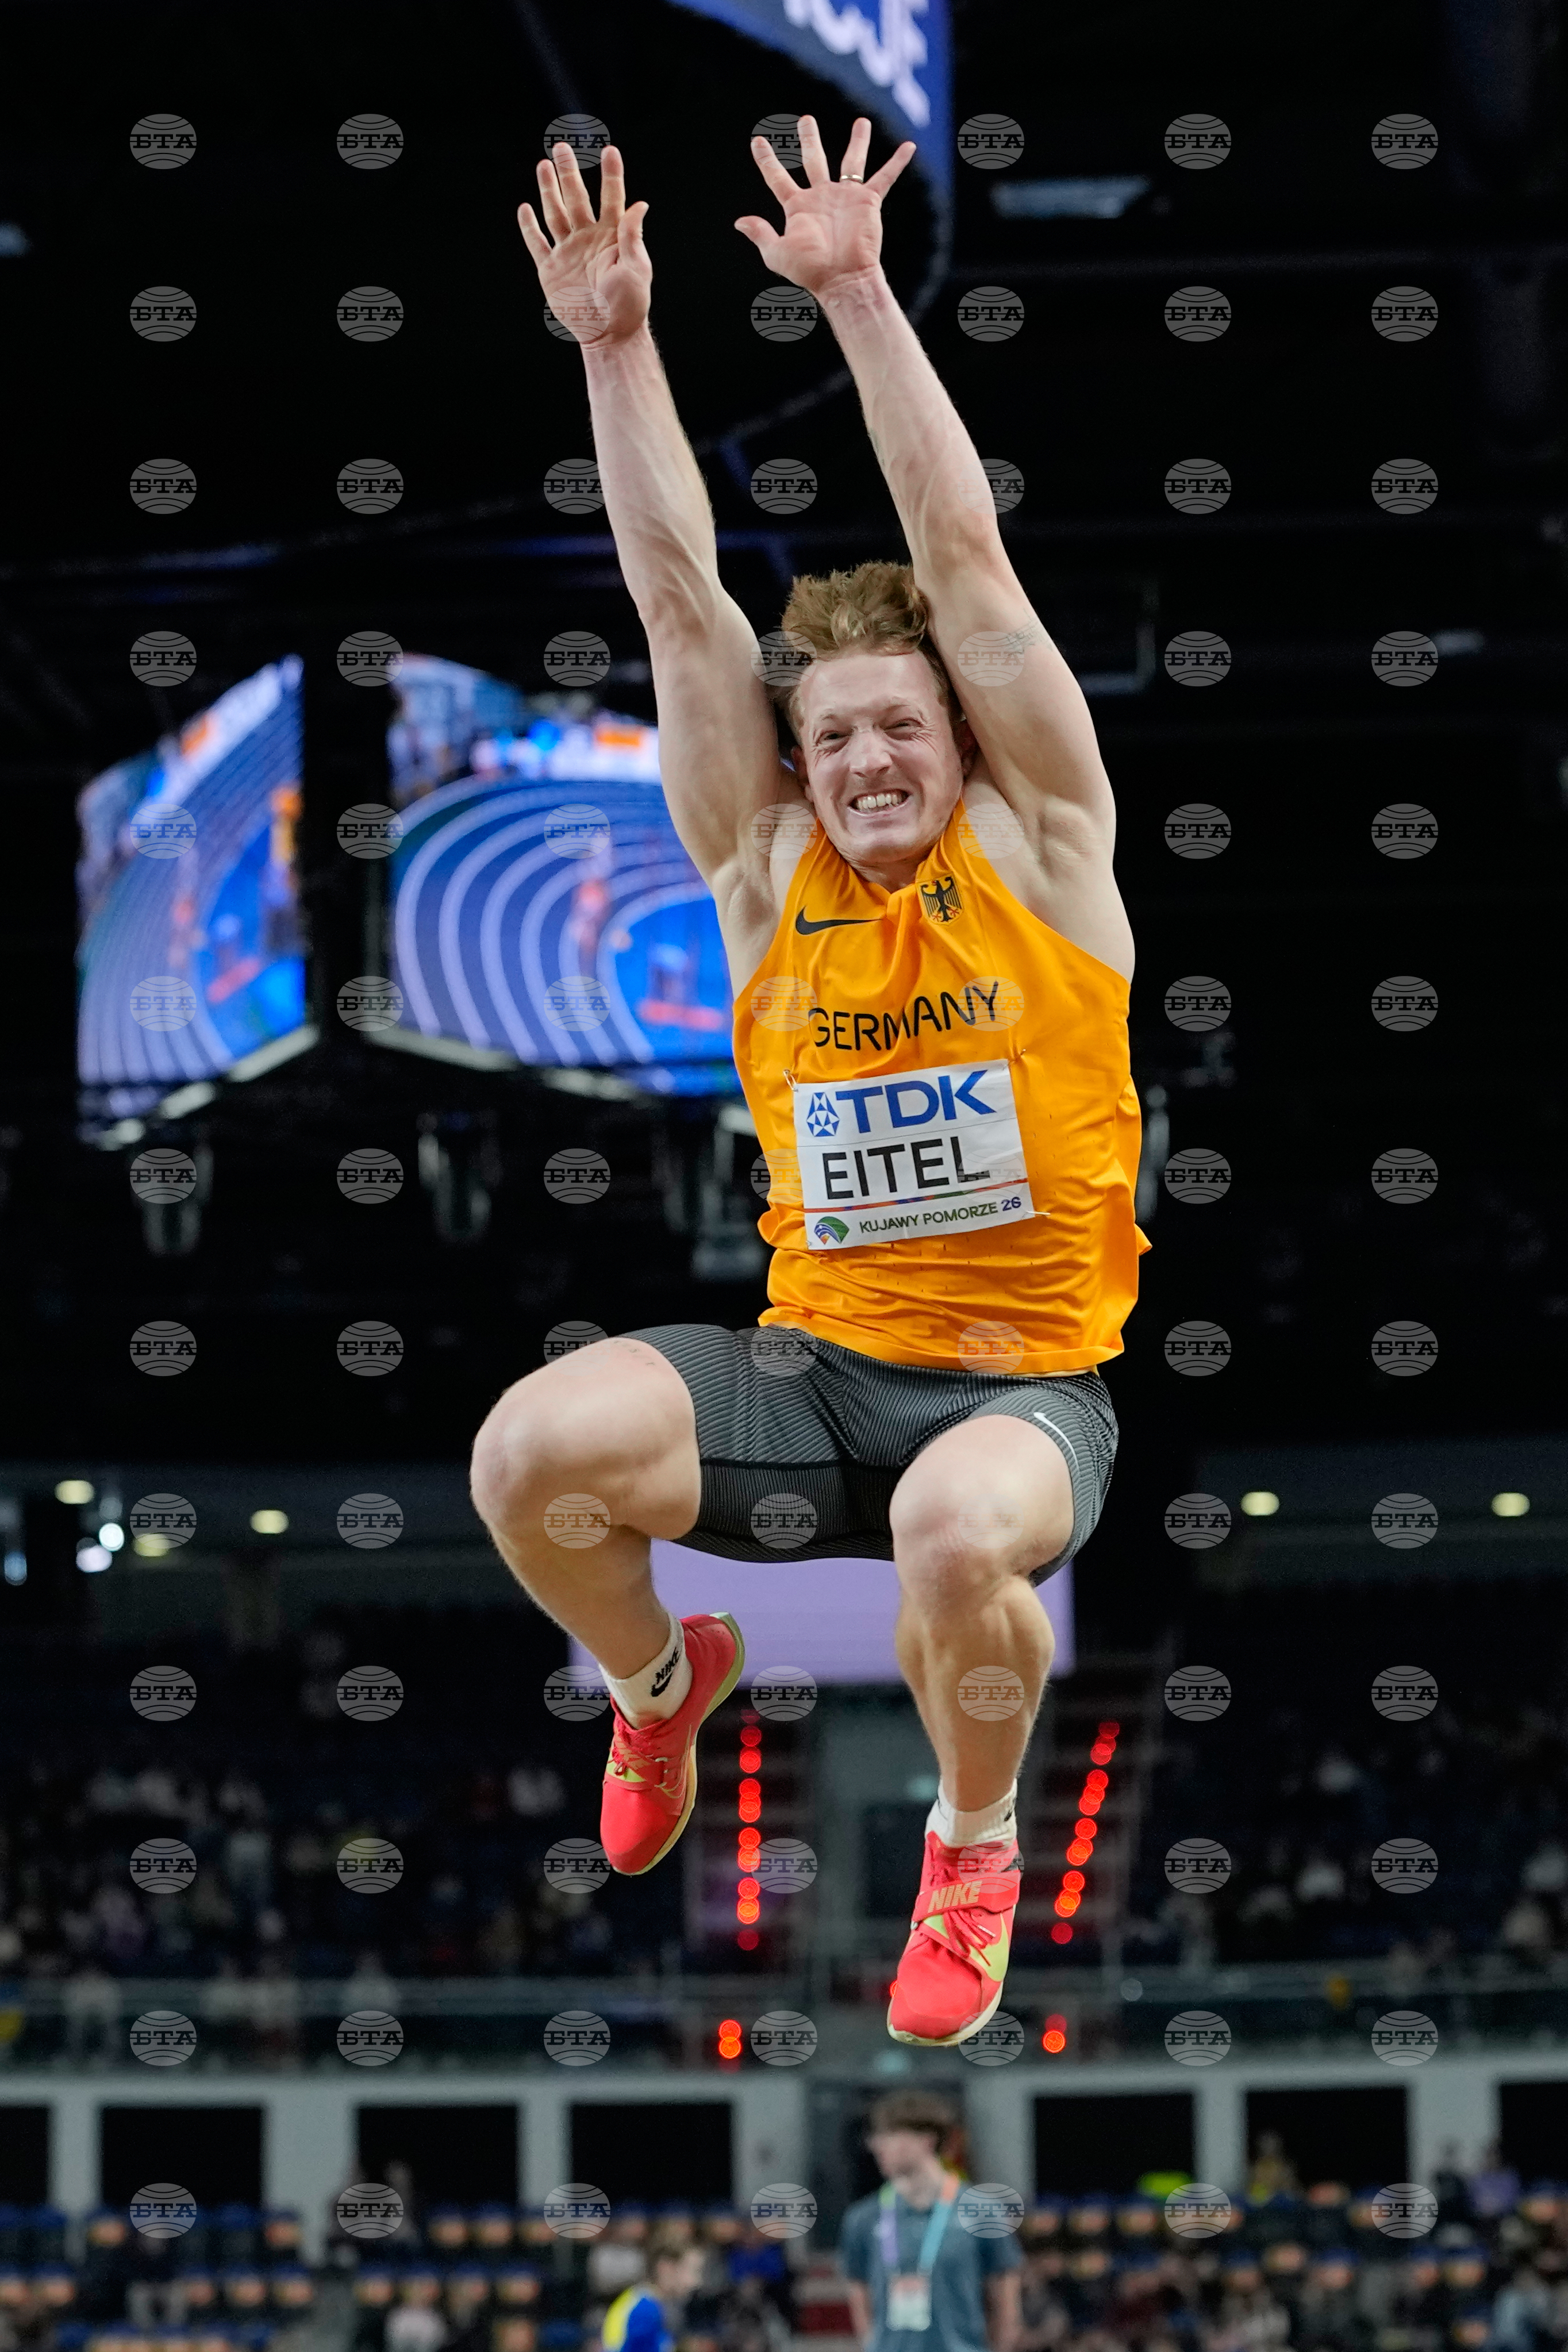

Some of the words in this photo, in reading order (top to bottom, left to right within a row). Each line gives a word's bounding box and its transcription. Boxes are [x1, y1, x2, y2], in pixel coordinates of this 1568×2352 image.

[808, 979, 999, 1051] GERMANY
[835, 1069, 997, 1134] TDK
[822, 1136, 991, 1200] EITEL
[859, 1214, 919, 1233] KUJAWY
[922, 1201, 998, 1225] POMORZE
[1001, 1196, 1022, 1212] 26
[927, 1879, 983, 1914] NIKE
